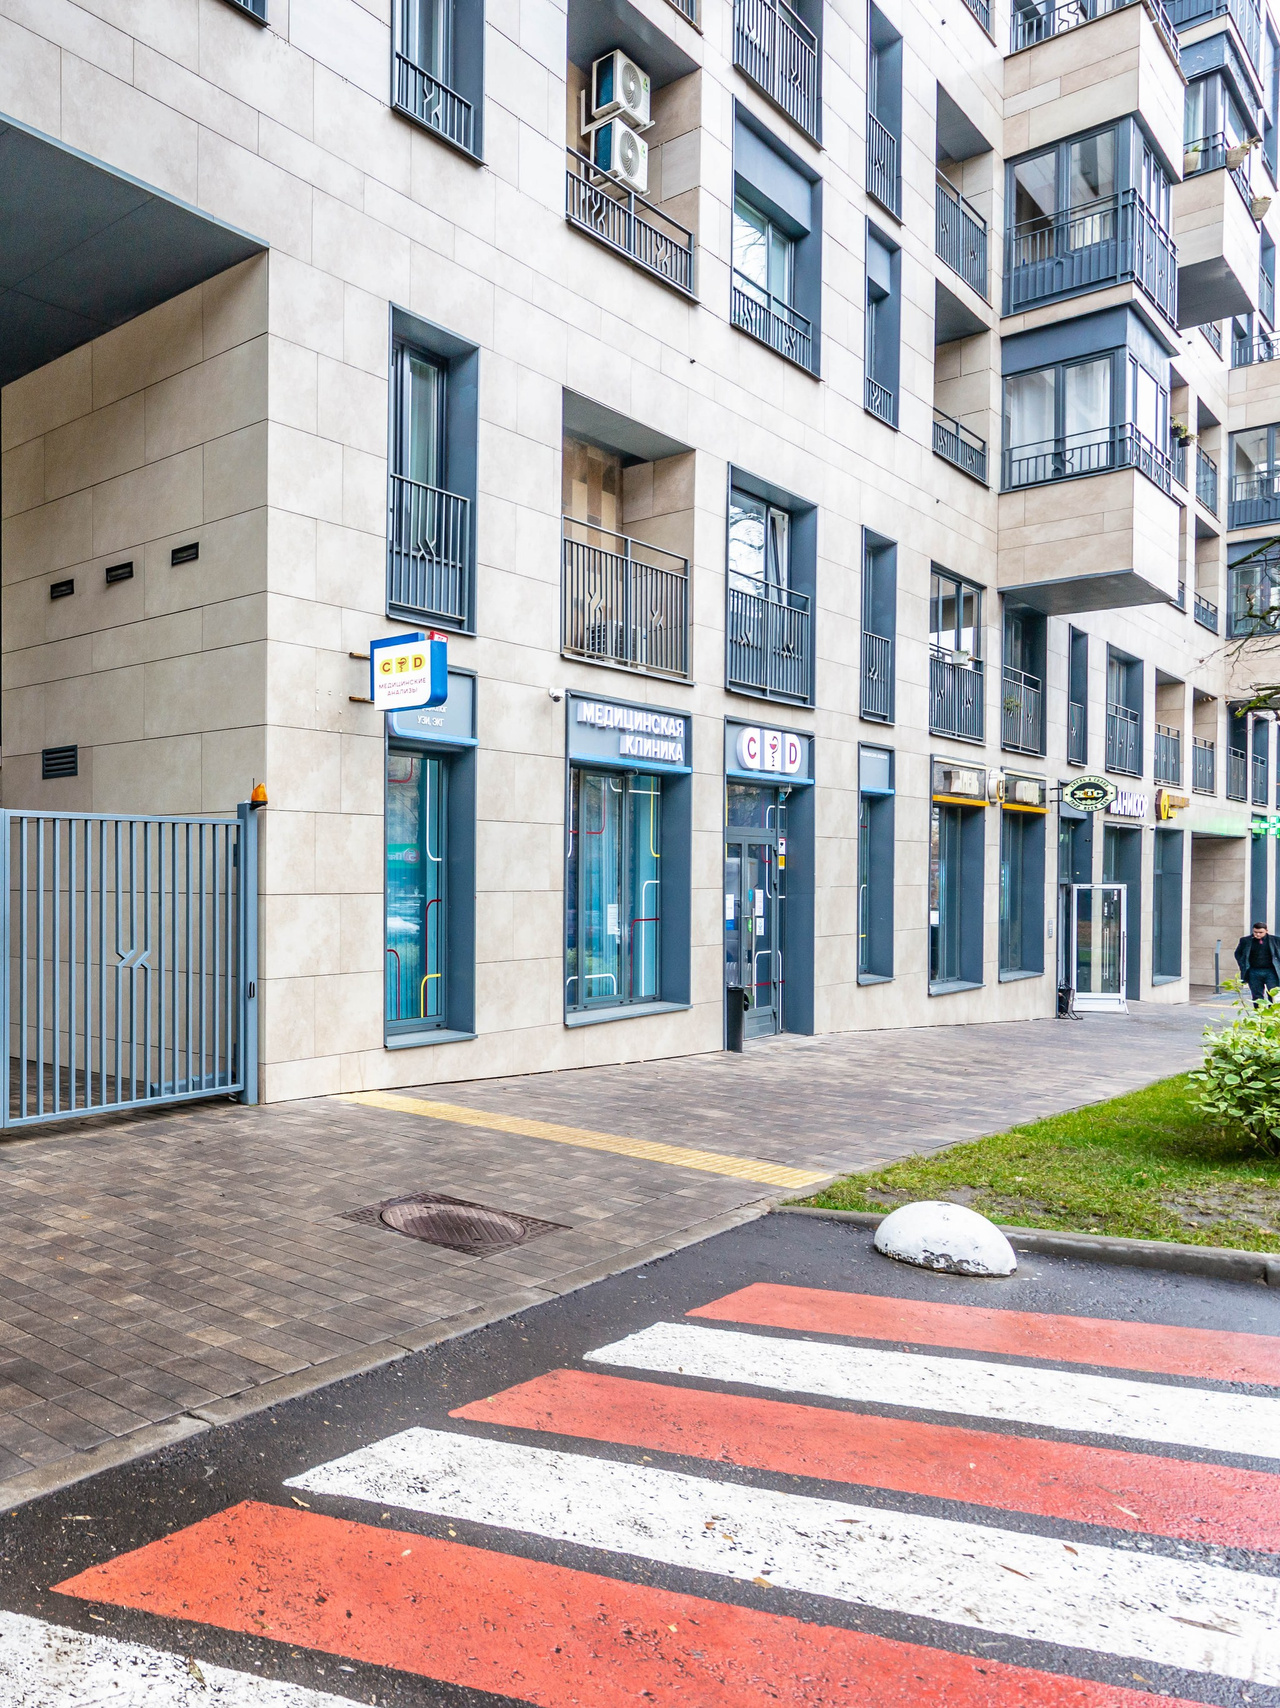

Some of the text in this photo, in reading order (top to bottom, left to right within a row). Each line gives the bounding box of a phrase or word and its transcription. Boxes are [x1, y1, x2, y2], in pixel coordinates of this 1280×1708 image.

[379, 677, 426, 689] МЕДИЦИНСКИЕ
[387, 687, 418, 696] АНАЛИЗЫ
[578, 701, 684, 737] МЕДИЦИНСКАЯ
[620, 734, 684, 761] КЛИНИКА
